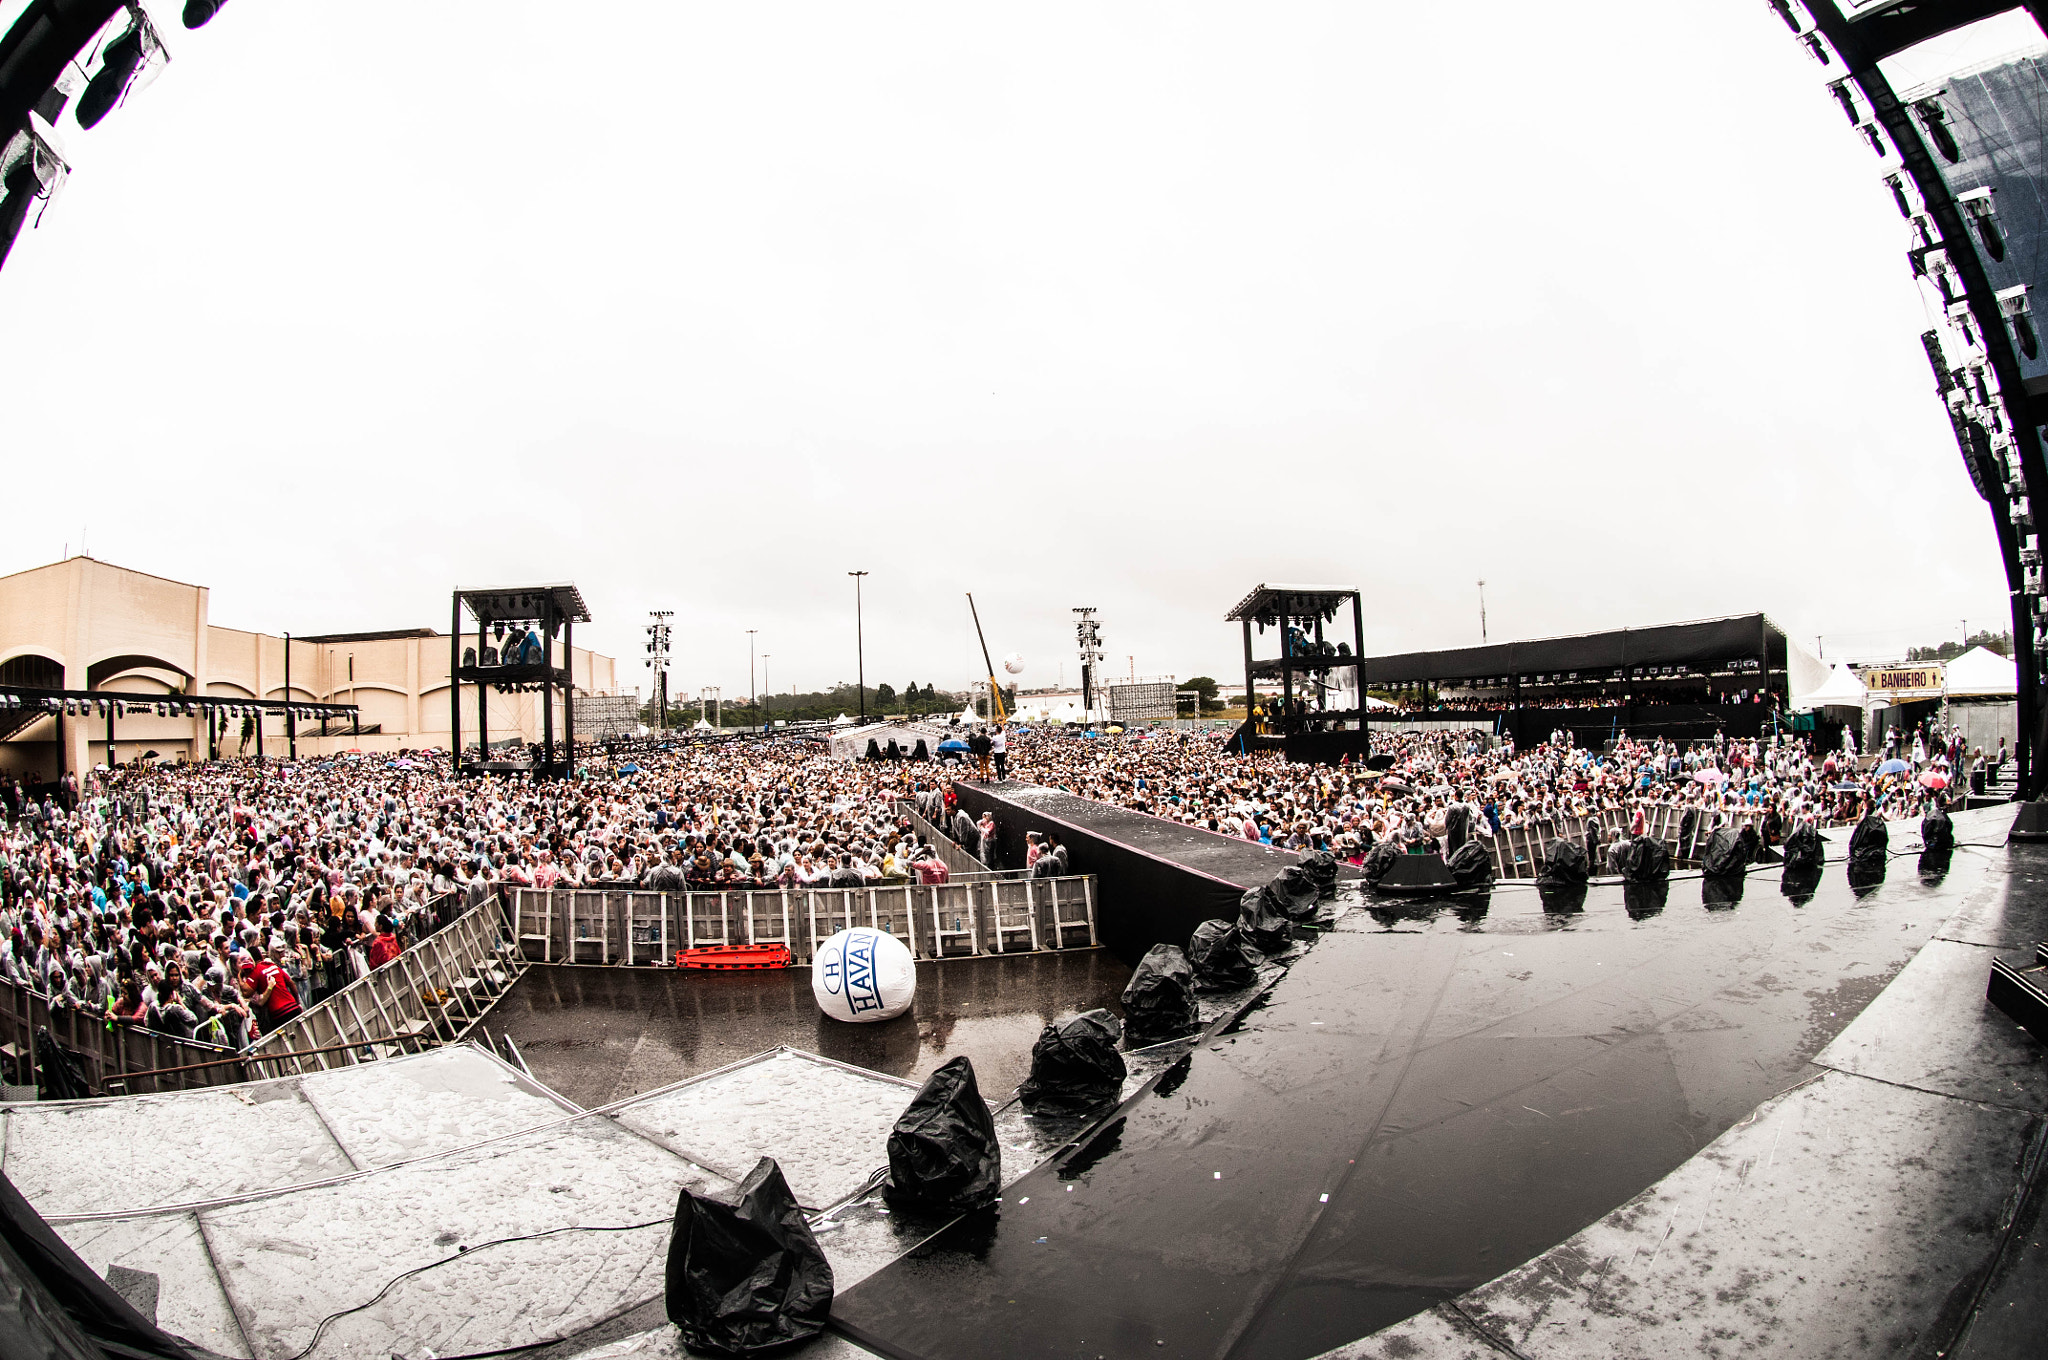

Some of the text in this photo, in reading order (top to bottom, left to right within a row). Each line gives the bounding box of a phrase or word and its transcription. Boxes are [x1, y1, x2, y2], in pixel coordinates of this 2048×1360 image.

[1881, 672, 1926, 688] BANHEIRO
[825, 962, 839, 977] H
[849, 933, 878, 1013] HAVAN
